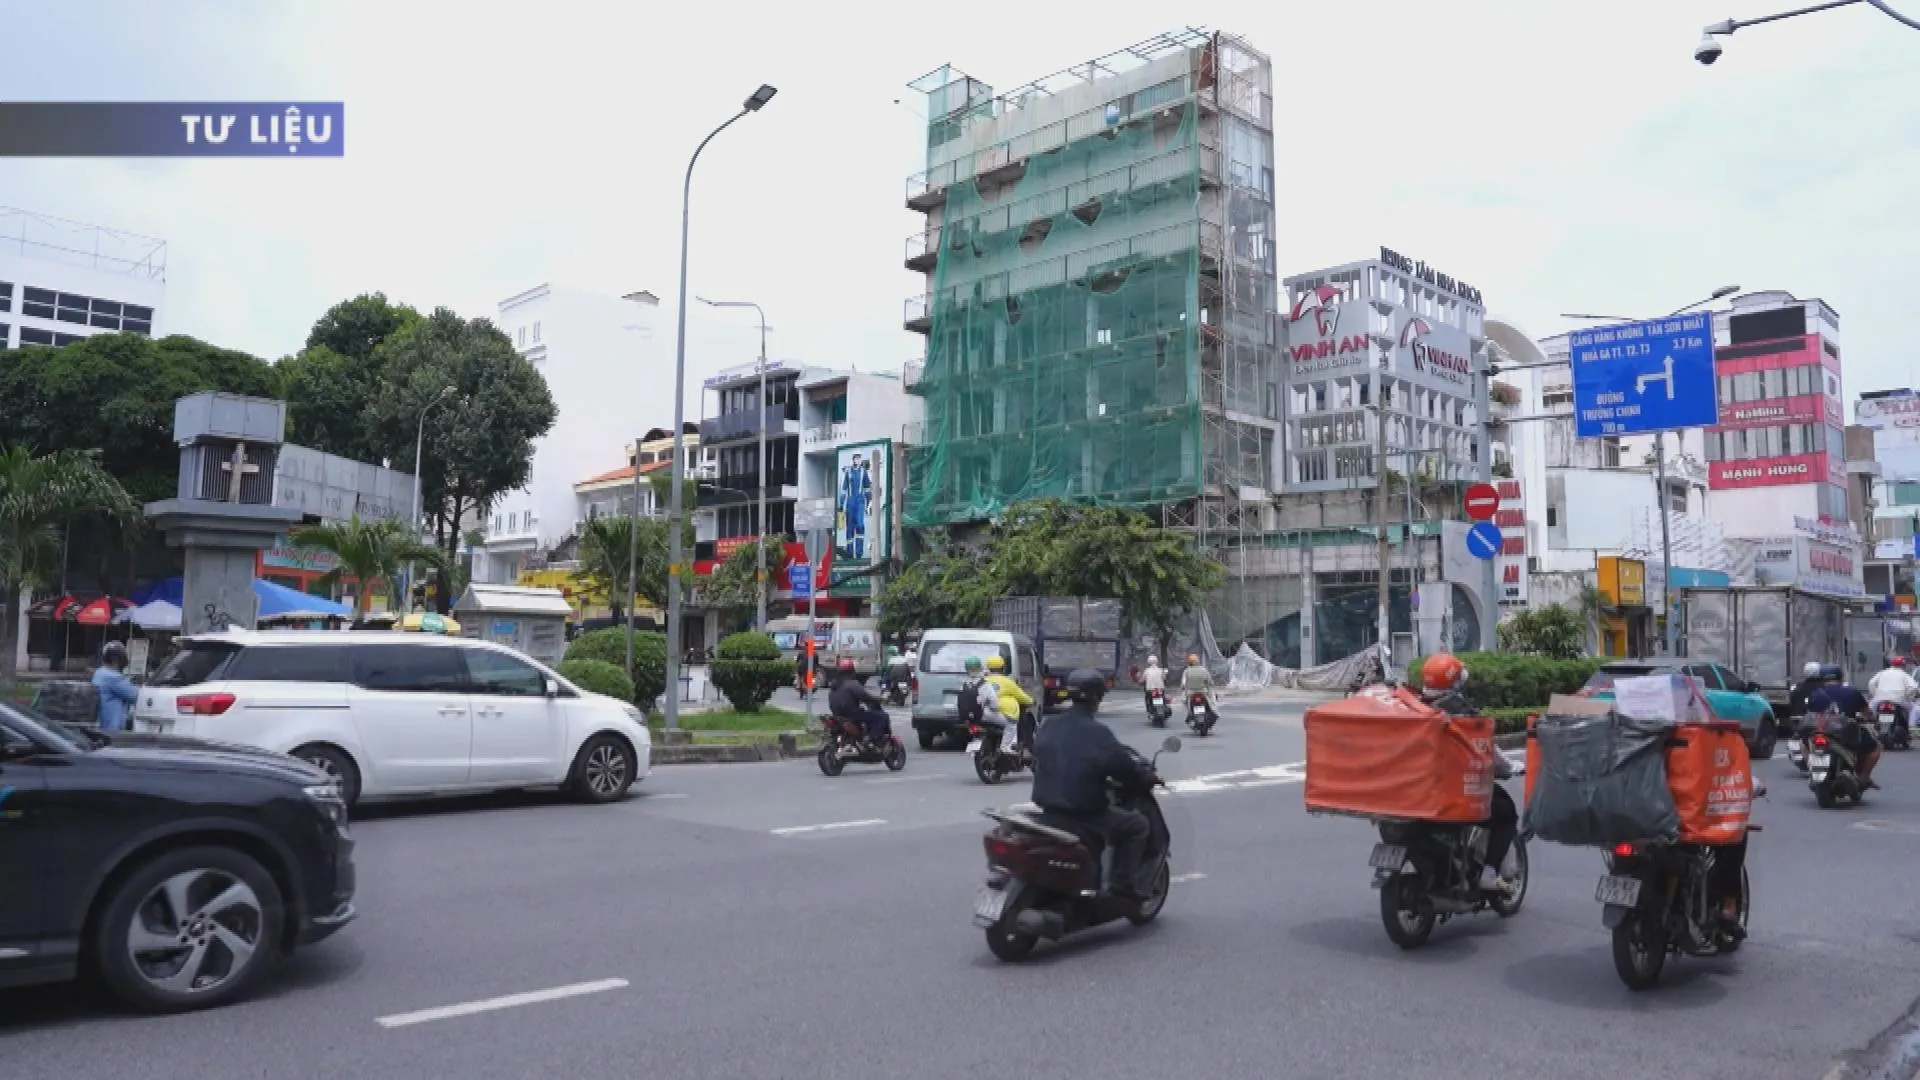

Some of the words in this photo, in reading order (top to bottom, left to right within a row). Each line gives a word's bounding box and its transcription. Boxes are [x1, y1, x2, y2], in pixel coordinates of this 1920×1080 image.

[1617, 326, 1644, 340] KHÔNG
[1648, 322, 1663, 335] TÂN
[1290, 338, 1335, 362] VINH
[1339, 332, 1369, 354] AN
[1616, 404, 1641, 417] CHINH
